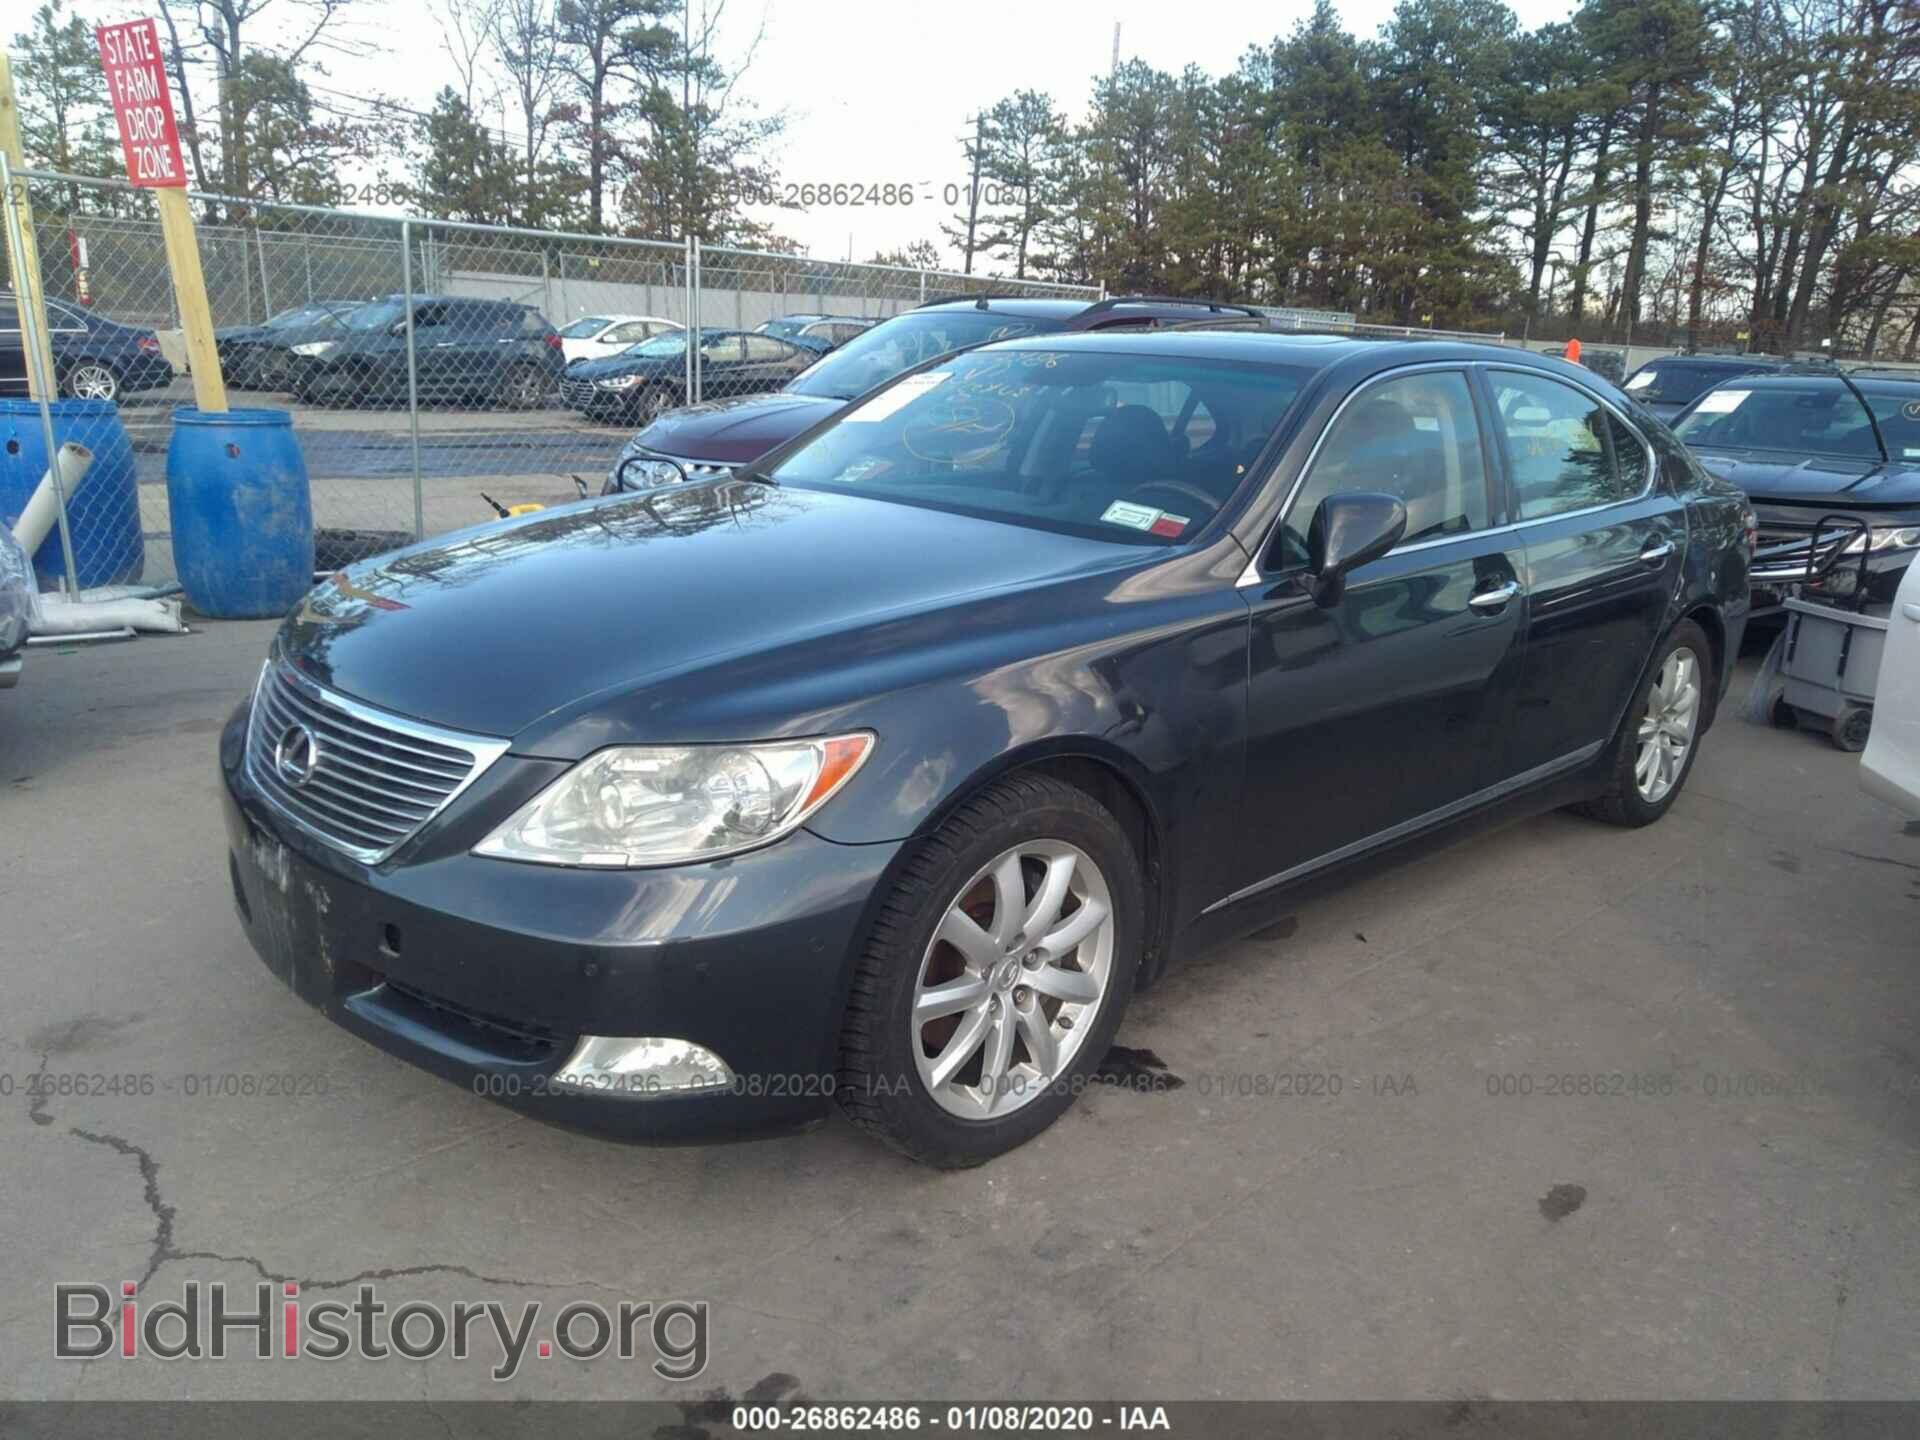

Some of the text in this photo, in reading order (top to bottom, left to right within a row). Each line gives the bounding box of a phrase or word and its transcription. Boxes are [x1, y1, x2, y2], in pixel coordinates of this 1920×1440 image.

[104, 24, 155, 65] STATE
[114, 65, 161, 104] FARM
[125, 105, 166, 142] DROP
[133, 143, 176, 179] ZONE
